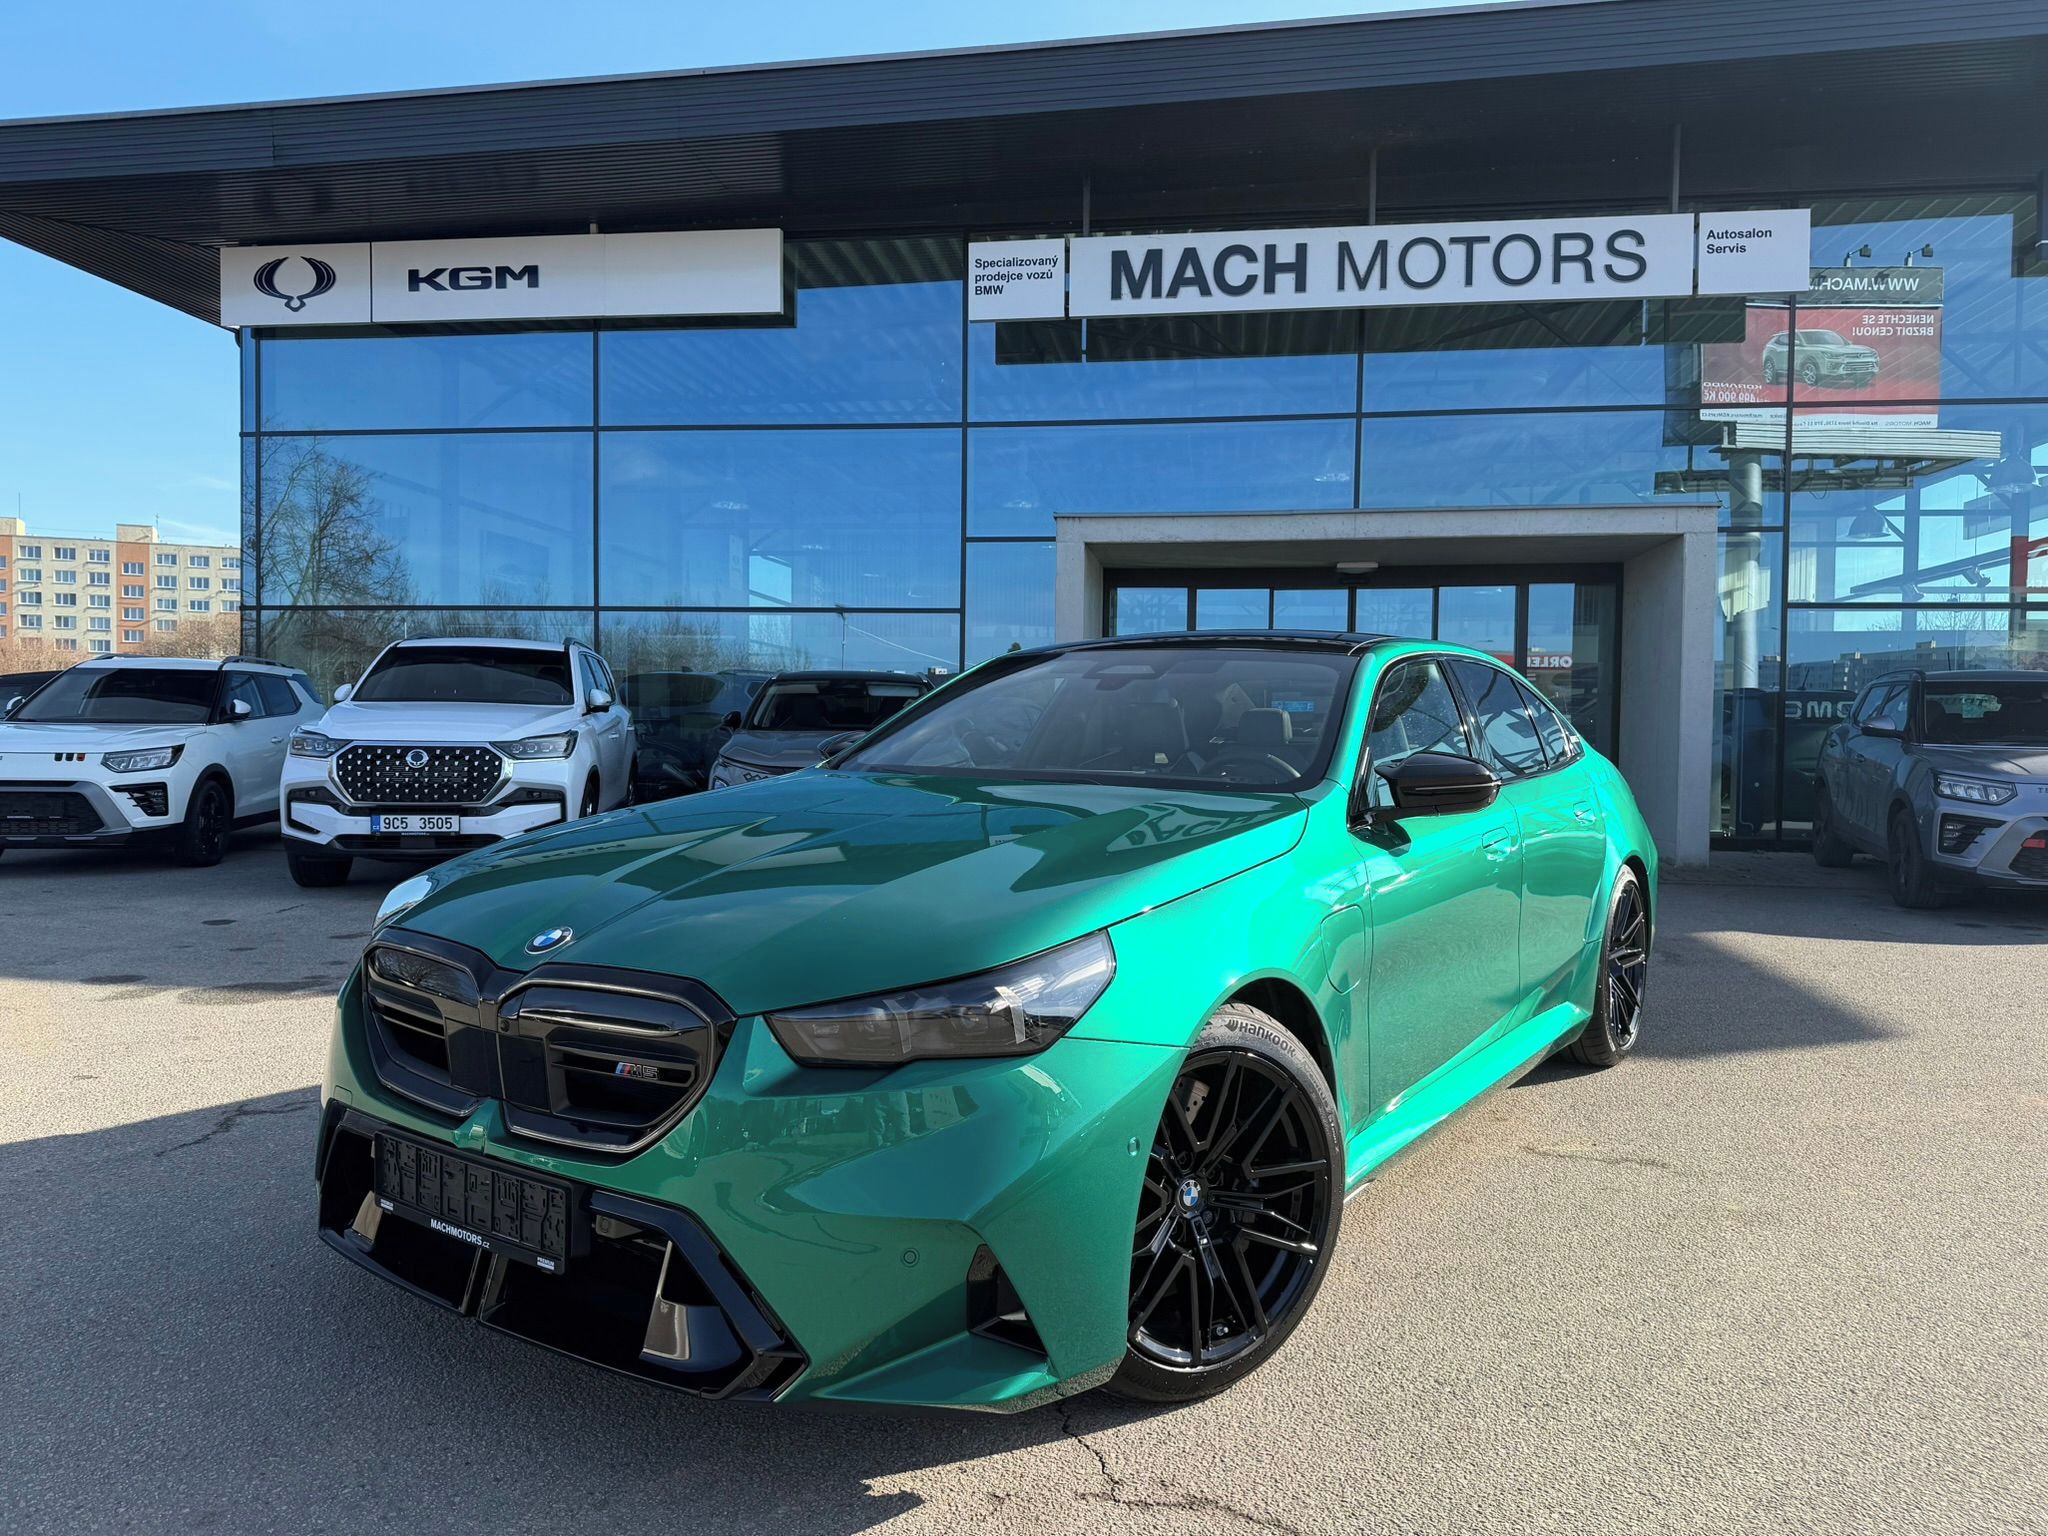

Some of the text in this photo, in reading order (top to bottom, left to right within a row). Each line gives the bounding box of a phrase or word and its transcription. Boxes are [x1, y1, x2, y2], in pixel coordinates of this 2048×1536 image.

[1706, 227, 1773, 240] Autosalon
[1706, 242, 1747, 255] Servis
[974, 255, 1059, 270] Specializovaný
[1110, 228, 1648, 301] MACH MOTORS
[408, 264, 539, 292] KGM
[974, 269, 1053, 284] prodejce vozů
[974, 285, 1004, 296] BMW
[383, 816, 453, 830] 9C5 3505
